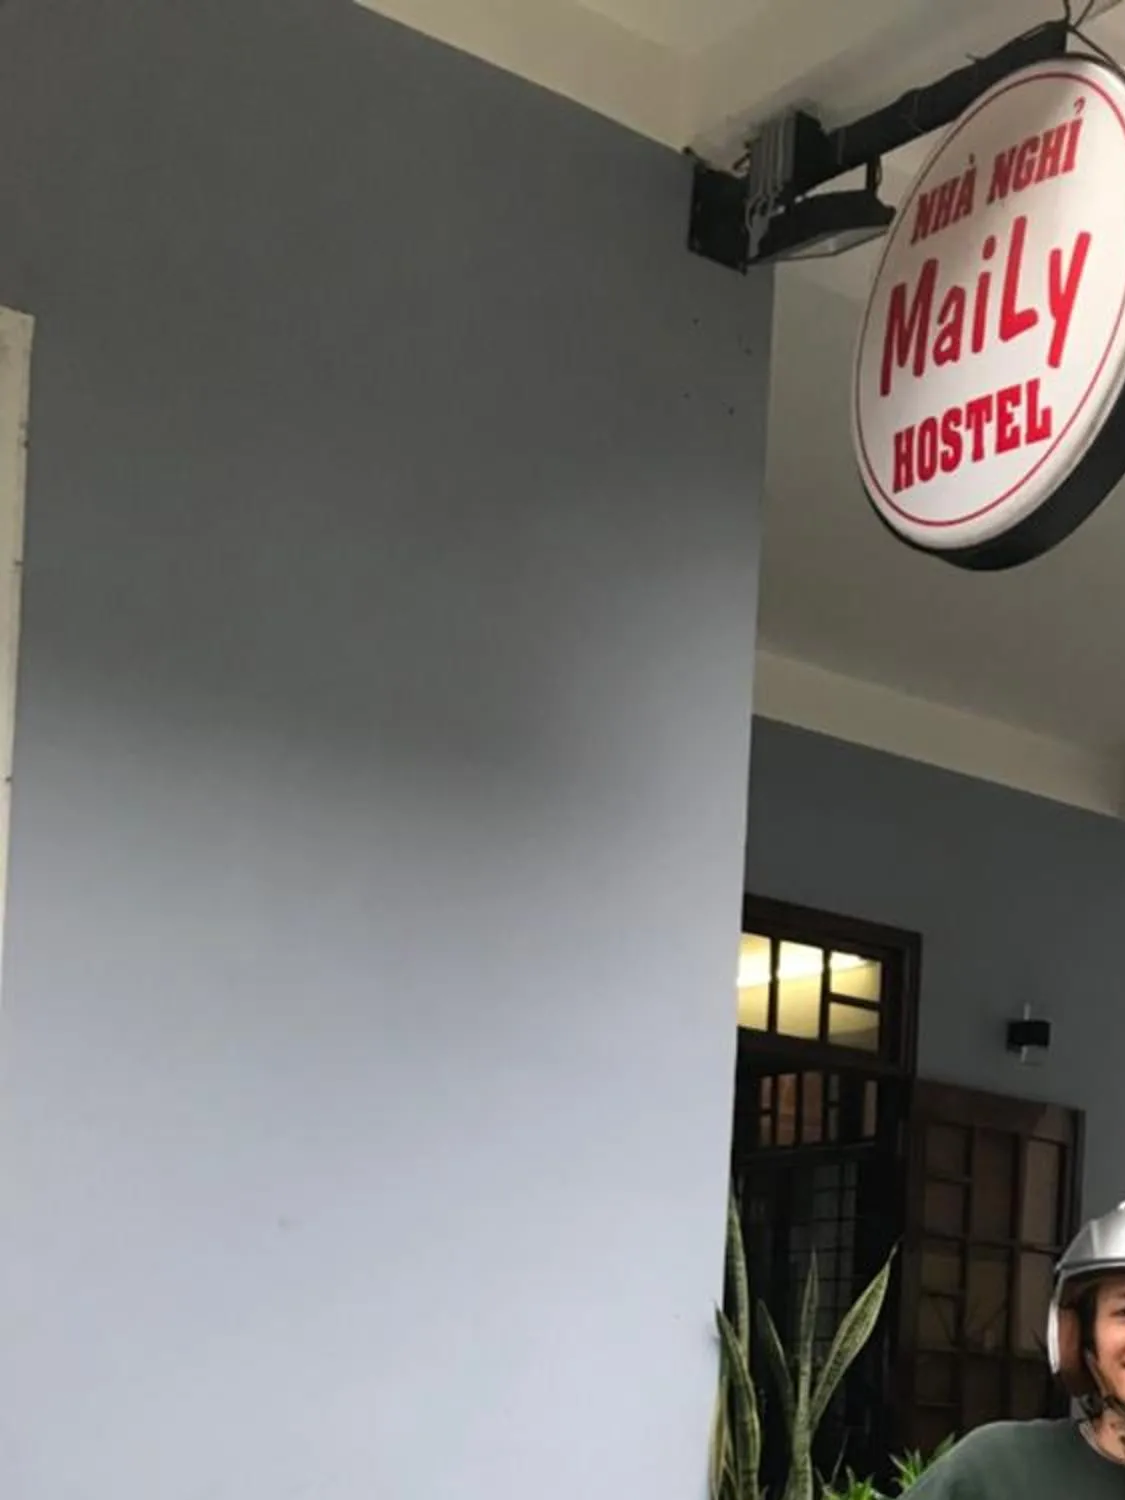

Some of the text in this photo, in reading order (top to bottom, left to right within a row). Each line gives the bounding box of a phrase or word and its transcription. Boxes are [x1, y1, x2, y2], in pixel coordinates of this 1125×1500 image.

[910, 96, 1086, 245] NHÀ NGHỈ
[892, 378, 1053, 494] HOSTEL
